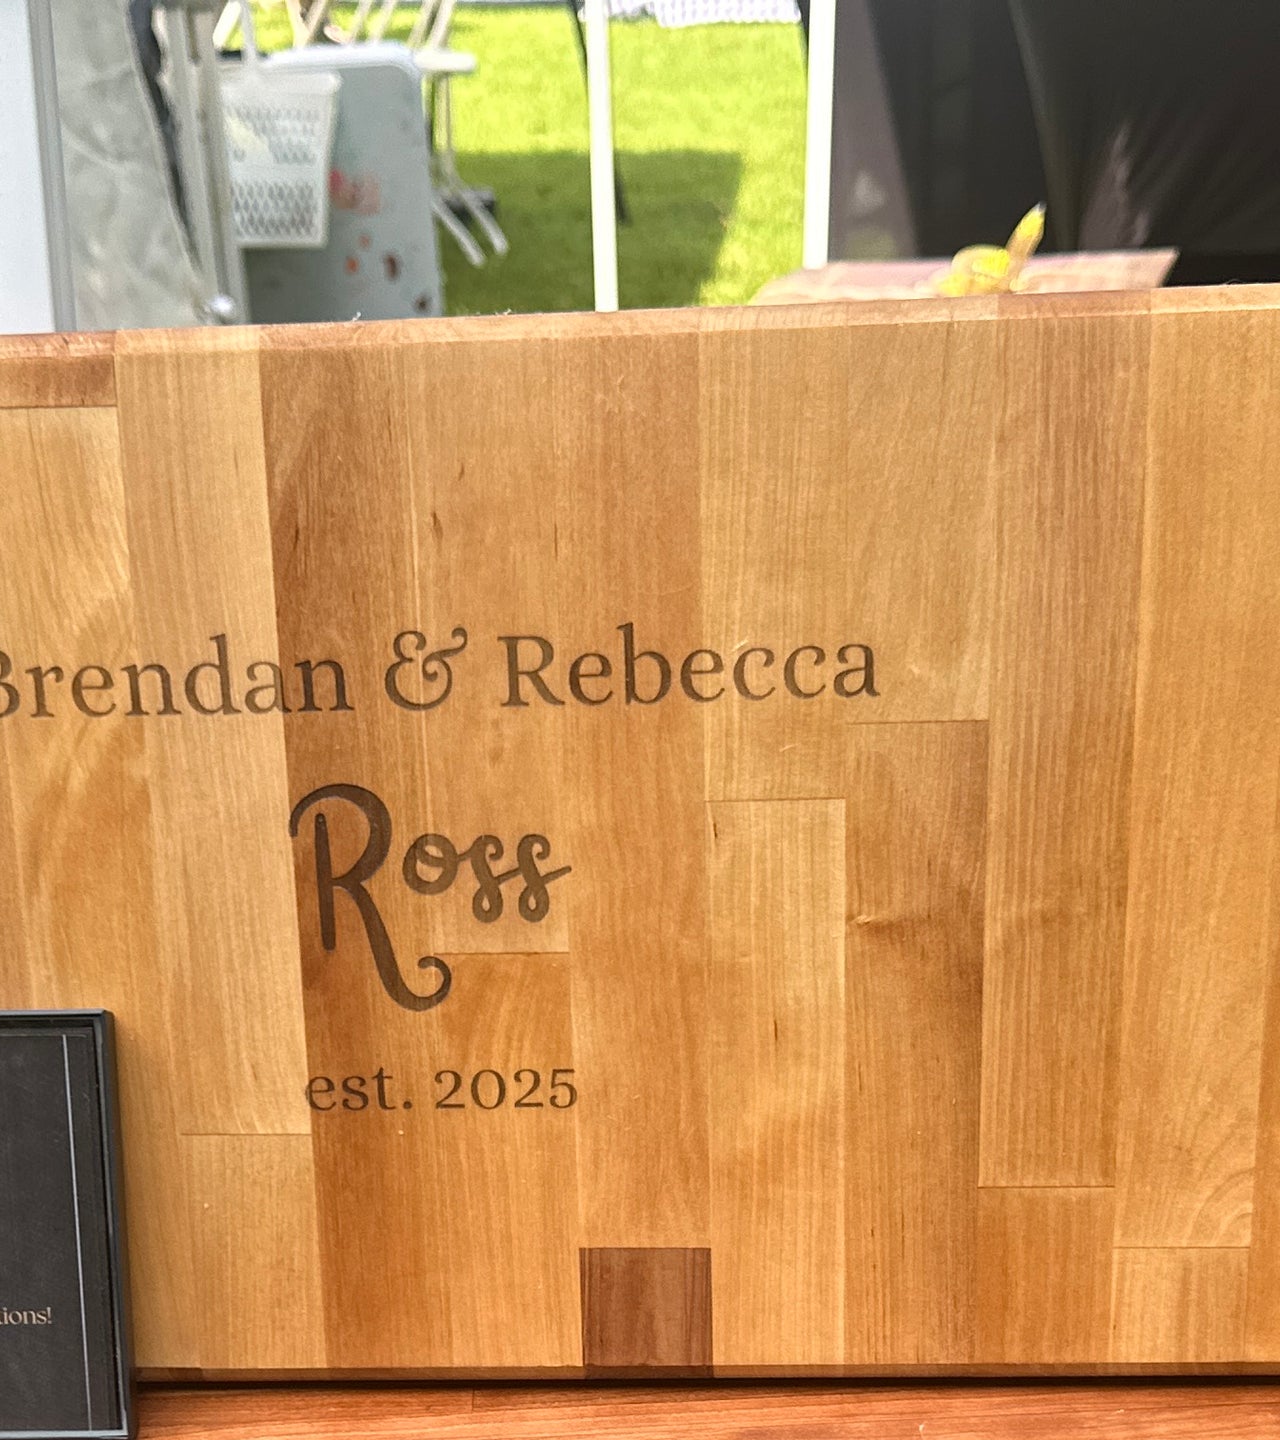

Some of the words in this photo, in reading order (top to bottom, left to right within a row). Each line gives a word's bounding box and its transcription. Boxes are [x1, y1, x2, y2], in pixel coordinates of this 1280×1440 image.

[384, 625, 468, 711] &
[498, 623, 879, 707] Rebecca
[288, 783, 572, 1012] Ross
[305, 1067, 412, 1113] est.
[435, 1067, 578, 1111] 2025
